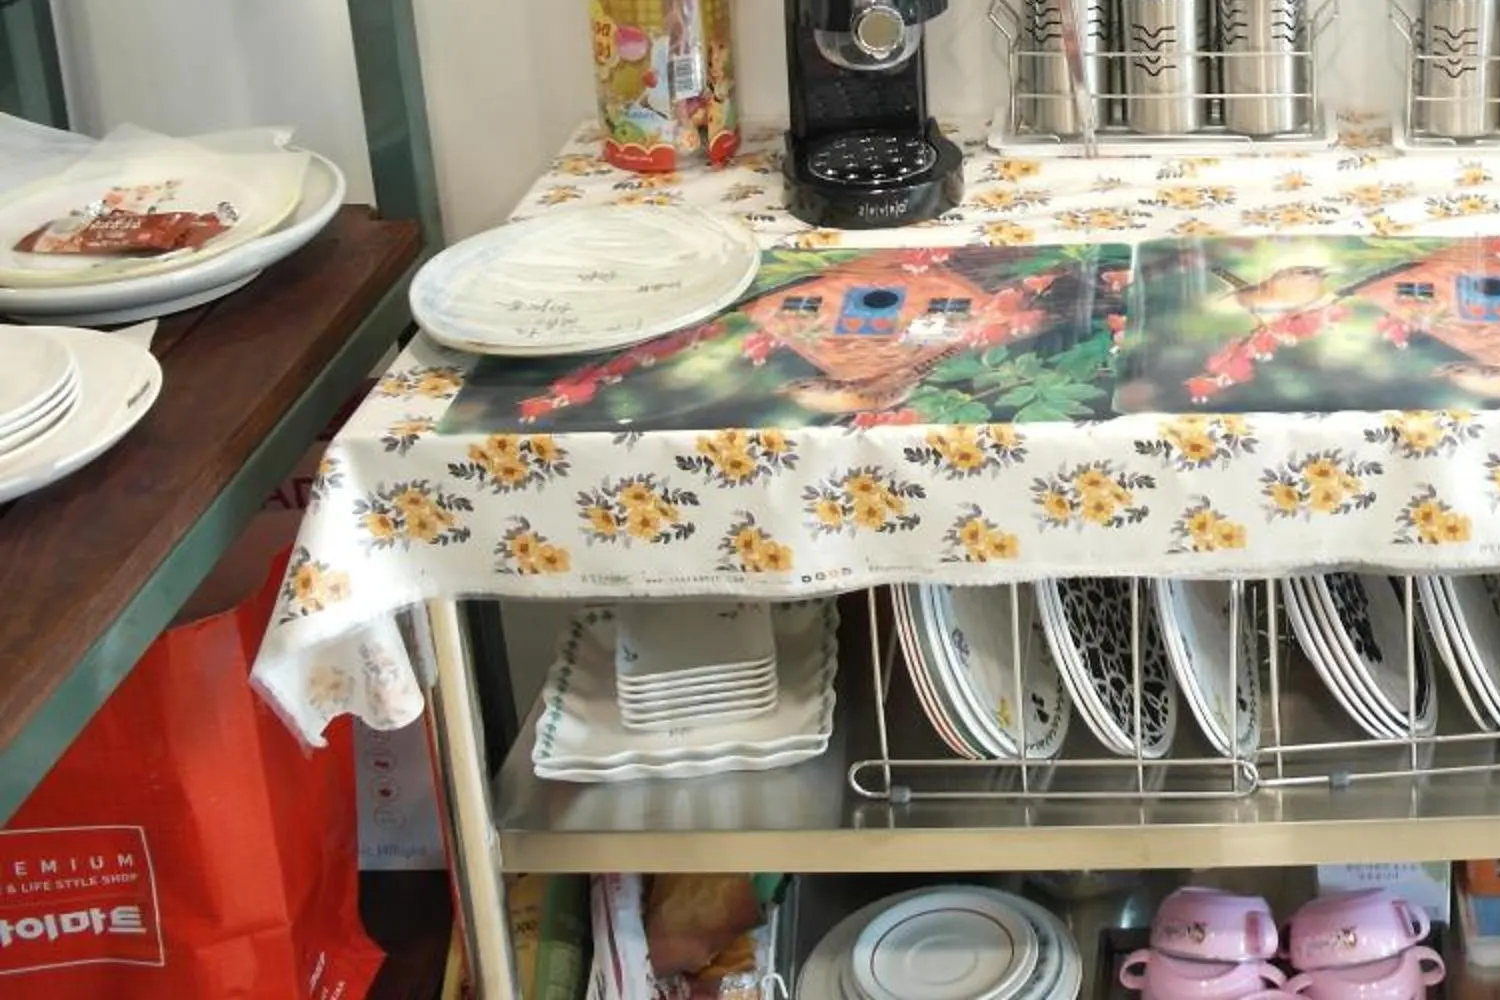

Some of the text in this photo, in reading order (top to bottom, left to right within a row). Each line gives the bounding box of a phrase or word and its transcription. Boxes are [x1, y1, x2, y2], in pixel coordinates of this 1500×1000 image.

[21, 880, 51, 893] LIFE
[56, 876, 98, 889] STYLE
[101, 873, 138, 885] SHOP
